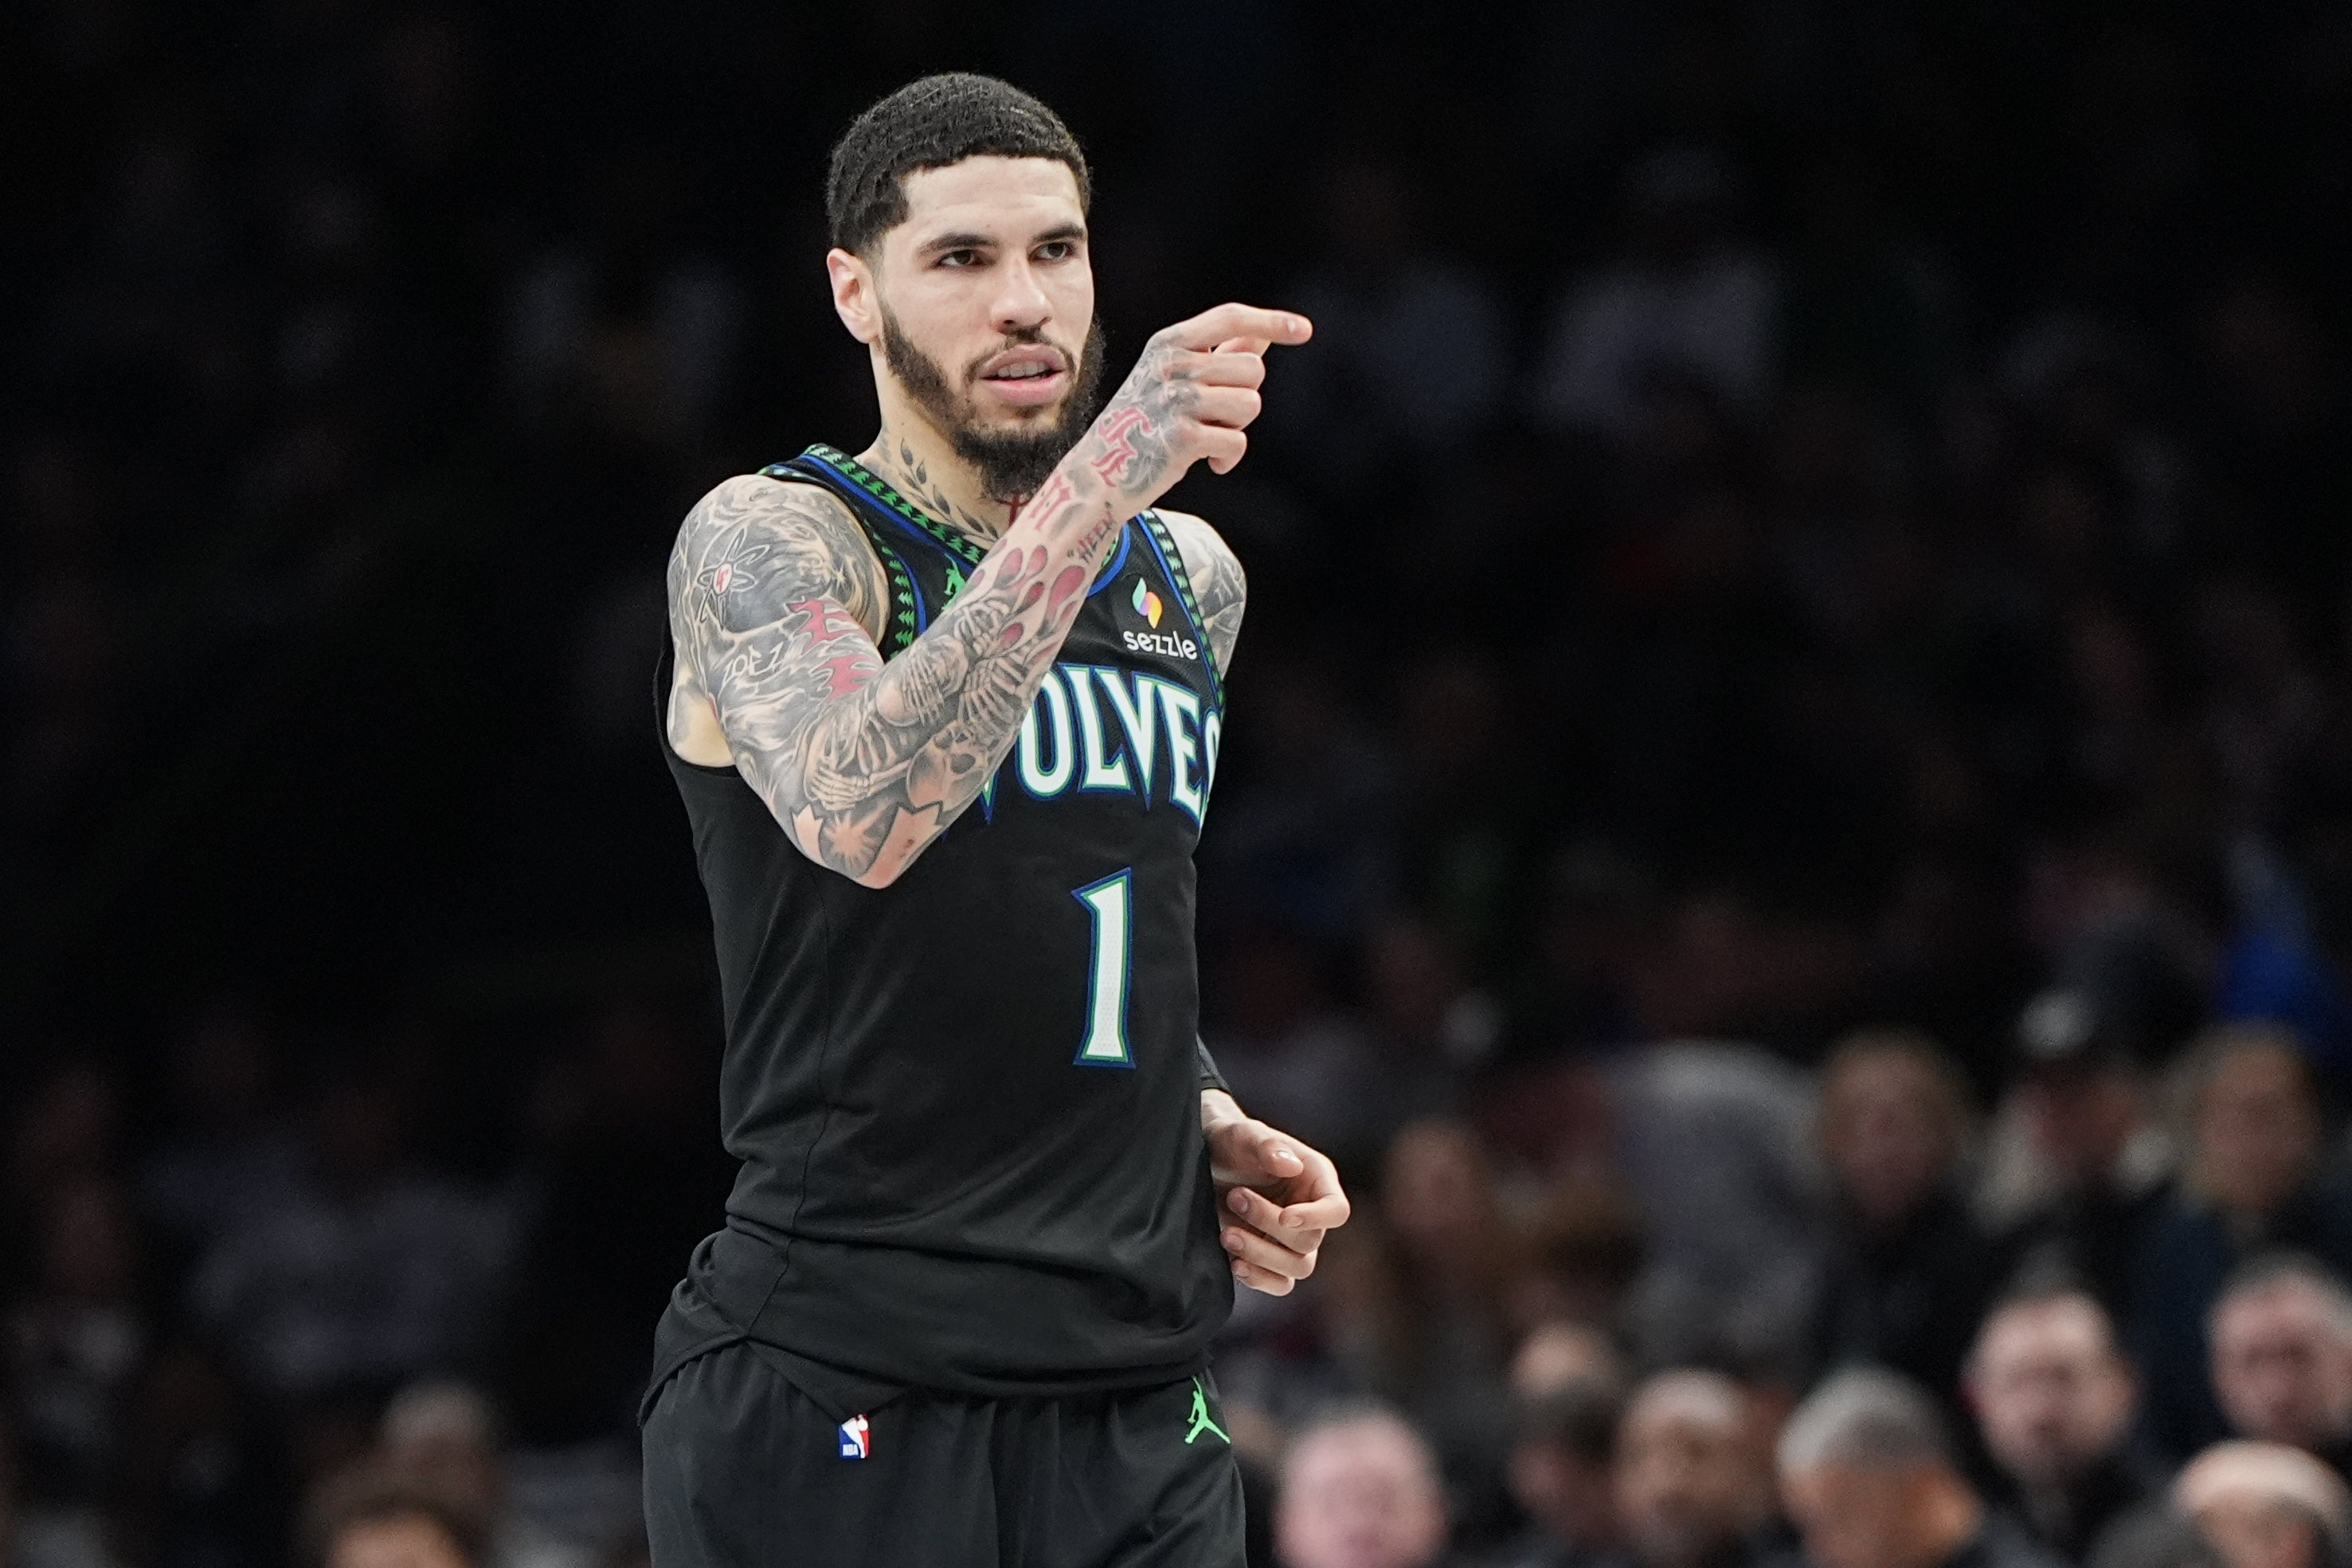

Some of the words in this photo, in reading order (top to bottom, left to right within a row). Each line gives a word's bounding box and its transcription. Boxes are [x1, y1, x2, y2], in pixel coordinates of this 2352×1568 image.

[1123, 630, 1198, 660] sezzle
[980, 661, 1224, 836] OLVE
[1070, 866, 1137, 1069] 1
